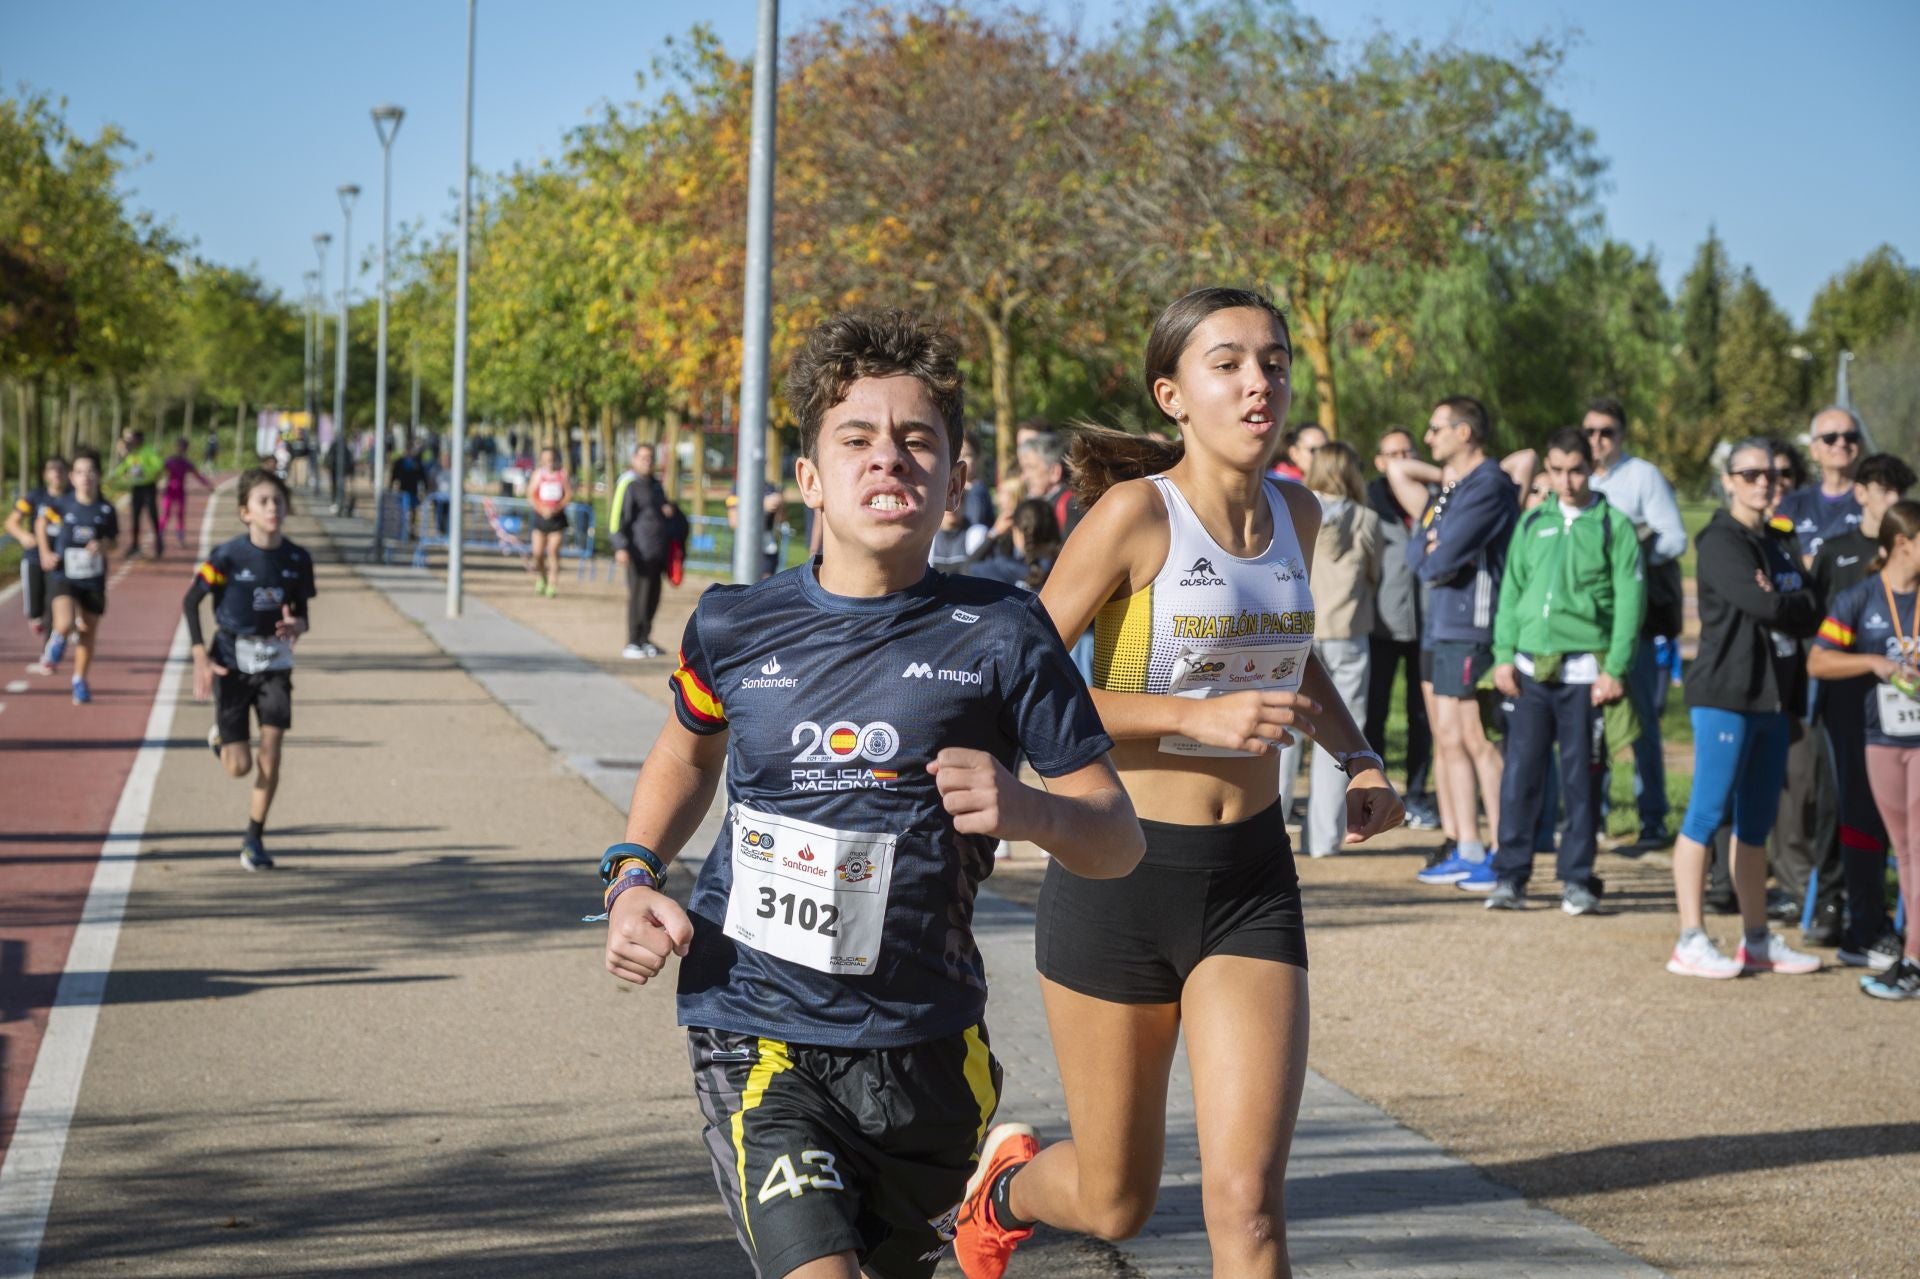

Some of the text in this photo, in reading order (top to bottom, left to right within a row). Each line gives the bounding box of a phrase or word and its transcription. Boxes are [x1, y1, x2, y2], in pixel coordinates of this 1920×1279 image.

[1173, 609, 1258, 638] TRIATLÓN
[938, 670, 982, 686] mupol
[1190, 662, 1225, 675] 200
[741, 676, 799, 690] Santander
[791, 721, 900, 763] 200
[791, 768, 876, 781] POLICIA
[791, 780, 898, 792] NACIONAL
[741, 825, 775, 850] 200
[782, 857, 828, 878] Santander
[756, 886, 840, 938] 3102
[757, 1150, 844, 1205] 43
